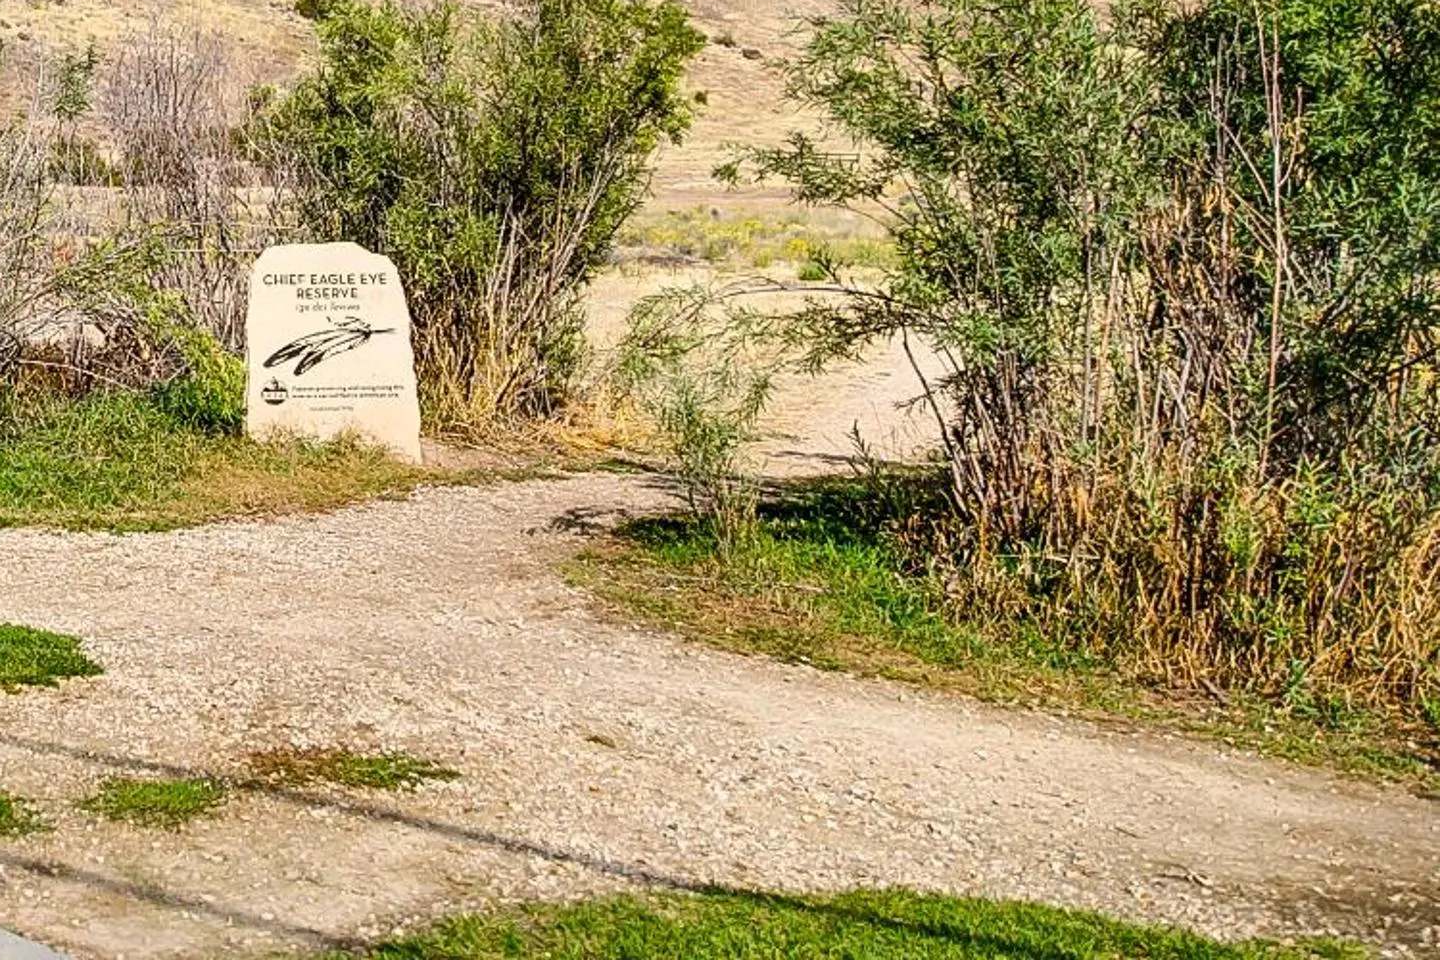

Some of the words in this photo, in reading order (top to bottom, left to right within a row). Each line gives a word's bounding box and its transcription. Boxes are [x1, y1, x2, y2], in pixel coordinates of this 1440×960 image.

[262, 274, 305, 286] CHIEF
[310, 273, 356, 285] EAGLE
[359, 273, 388, 285] EYE
[296, 287, 359, 299] RESERVE
